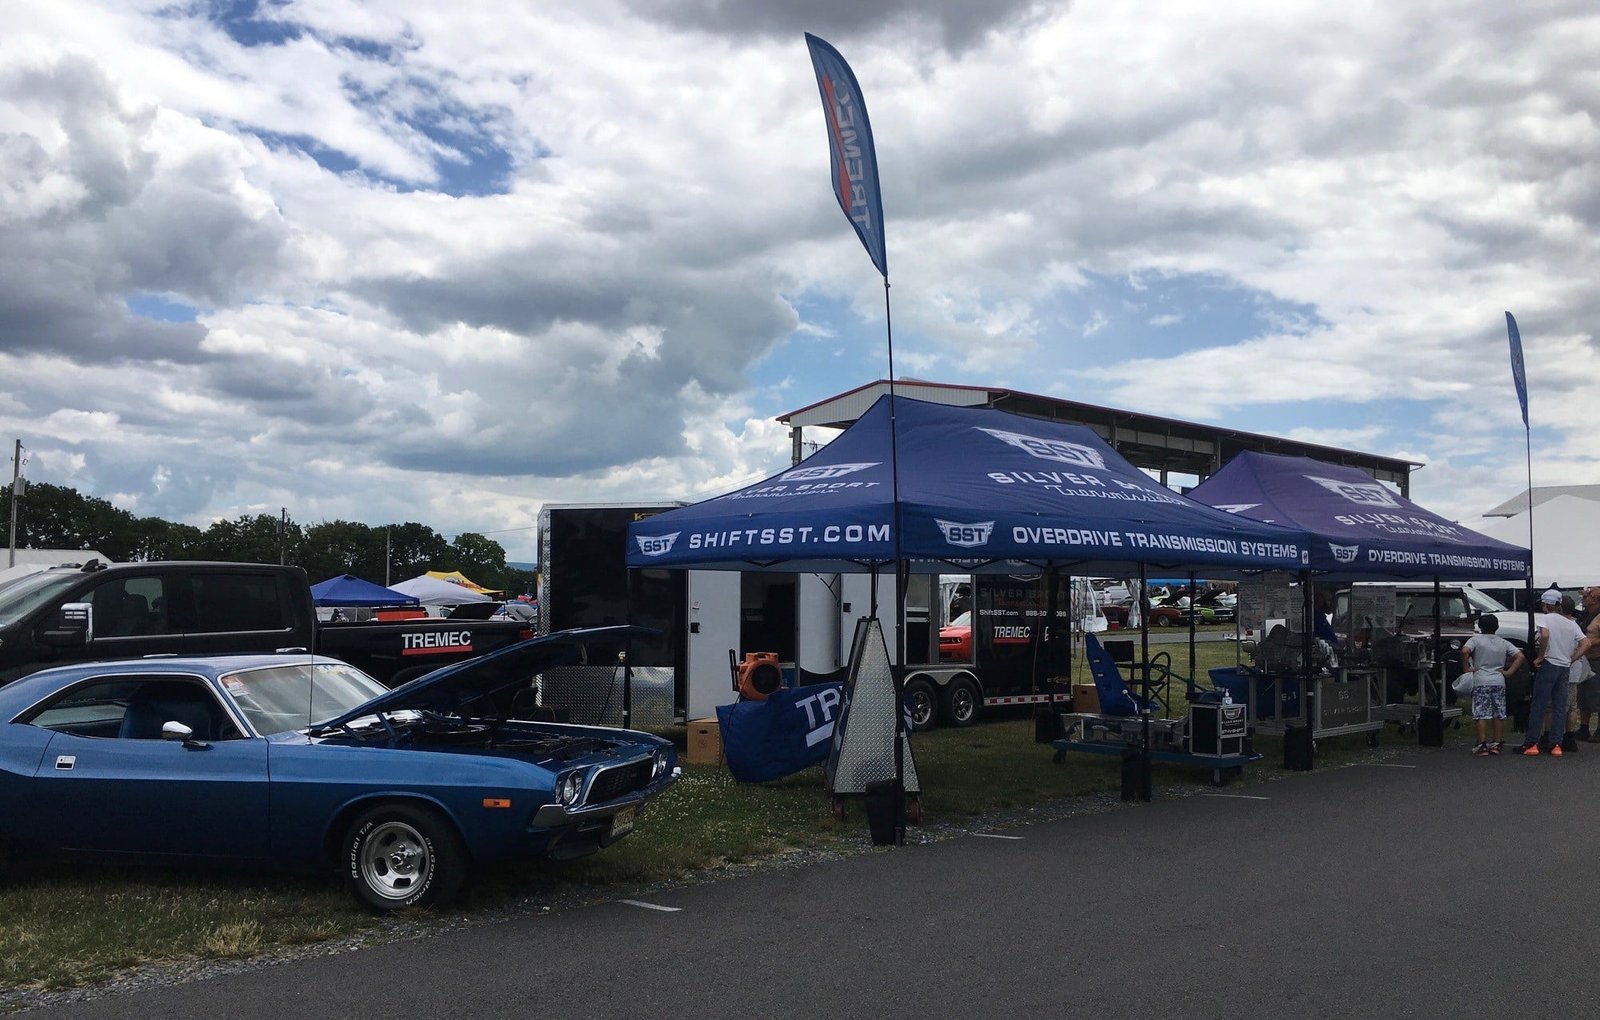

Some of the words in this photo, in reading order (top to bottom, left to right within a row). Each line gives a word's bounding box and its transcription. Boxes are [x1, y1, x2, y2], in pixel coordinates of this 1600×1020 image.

[796, 482, 880, 491] SPORT
[987, 471, 1106, 487] SILVER
[1334, 513, 1410, 526] SILVER
[1409, 517, 1464, 536] SPORT
[689, 524, 890, 549] SHIFTSST.COM
[949, 526, 985, 543] SST
[1012, 526, 1123, 547] OVERDRIVE
[1126, 531, 1238, 555] TRANSMISSION
[1240, 541, 1298, 558] SYSTEMS
[643, 538, 671, 553] SST
[1368, 549, 1427, 565] OVERDRIVE
[1429, 553, 1491, 568] TRANSMISSION
[1493, 559, 1525, 572] SYSTEMS
[401, 630, 471, 649] TREMEC
[993, 625, 1030, 639] TREMEC
[351, 837, 361, 880] Radial
[359, 820, 374, 837] T/A
